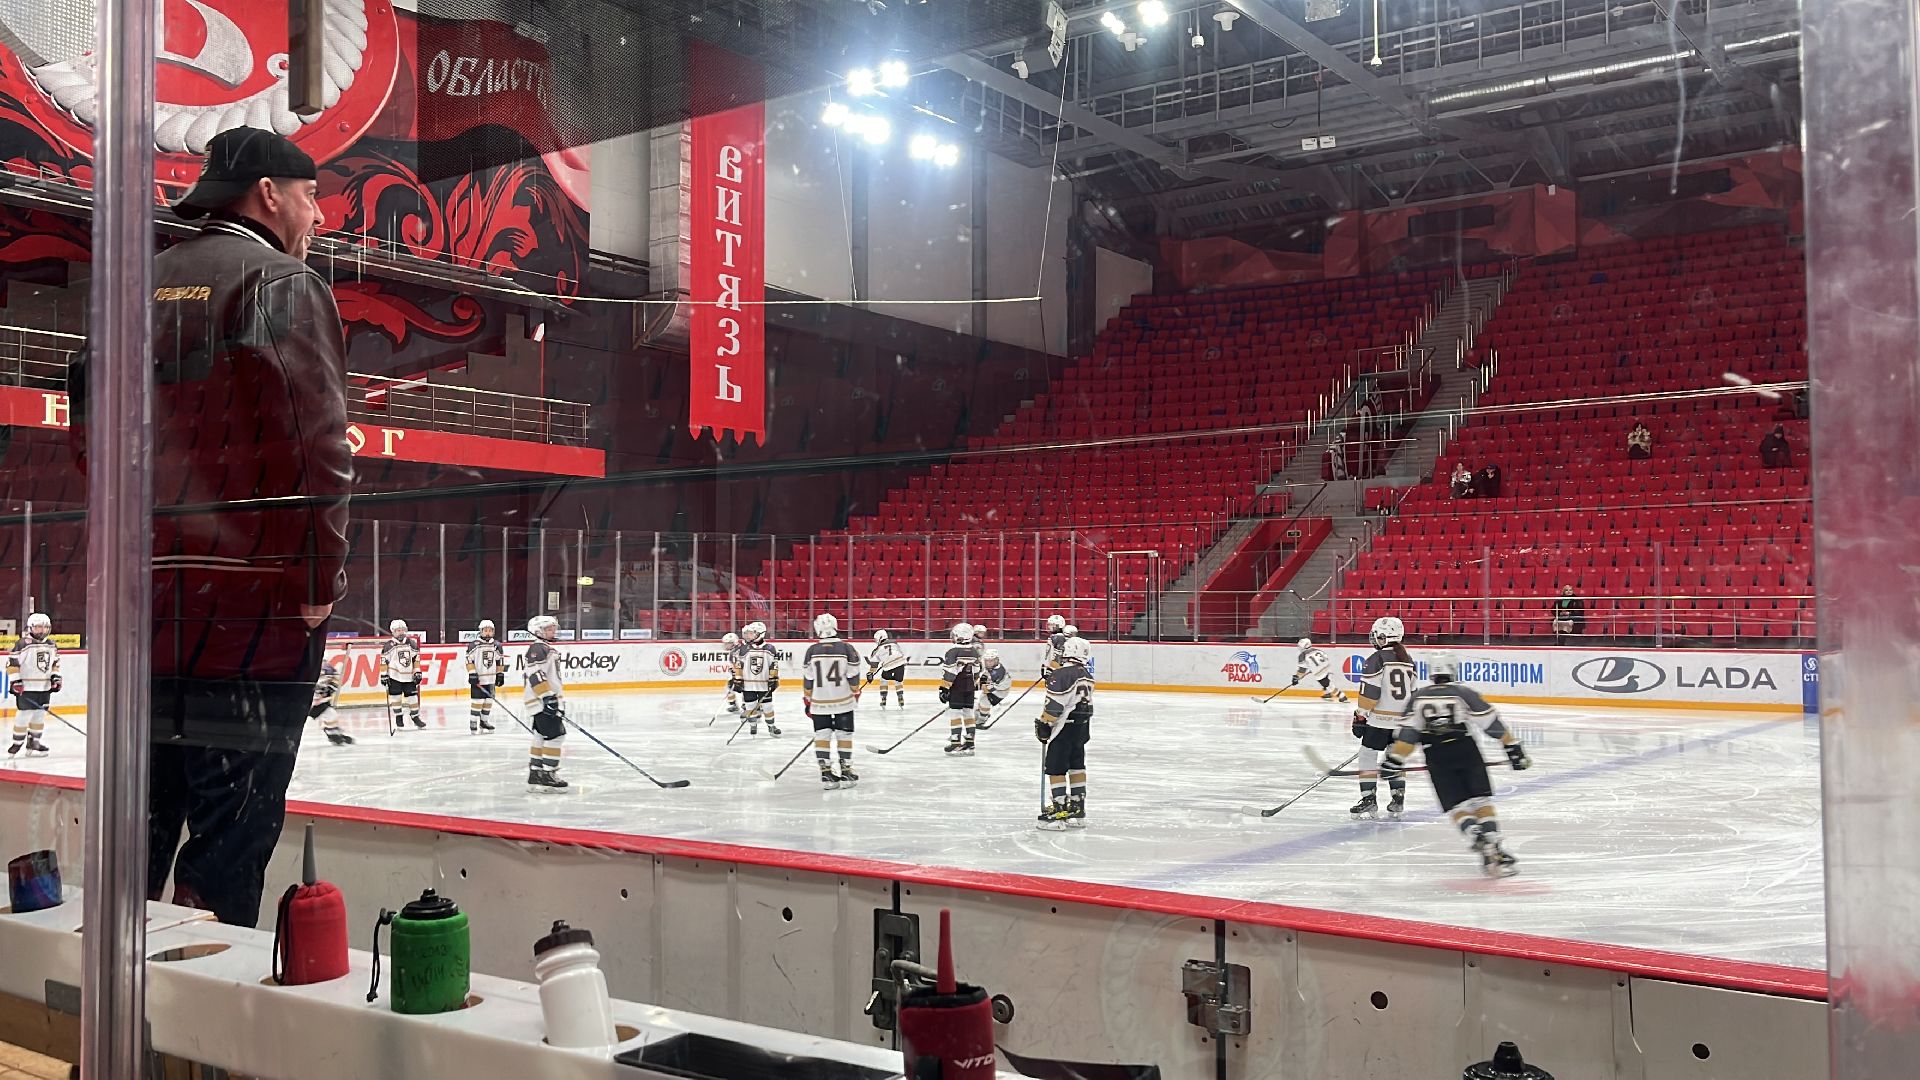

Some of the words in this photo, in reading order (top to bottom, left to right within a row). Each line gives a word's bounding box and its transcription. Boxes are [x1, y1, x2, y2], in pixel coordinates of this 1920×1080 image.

[715, 145, 742, 403] ВИТЯЗЬ
[346, 425, 405, 456] ОГ
[692, 652, 730, 662] БИЛЕТ
[883, 645, 893, 656] 7
[1308, 652, 1326, 667] 13
[815, 660, 842, 688] 14
[1221, 664, 1248, 673] АВТО
[1228, 673, 1263, 683] РАДИО
[1676, 666, 1778, 691] LADA
